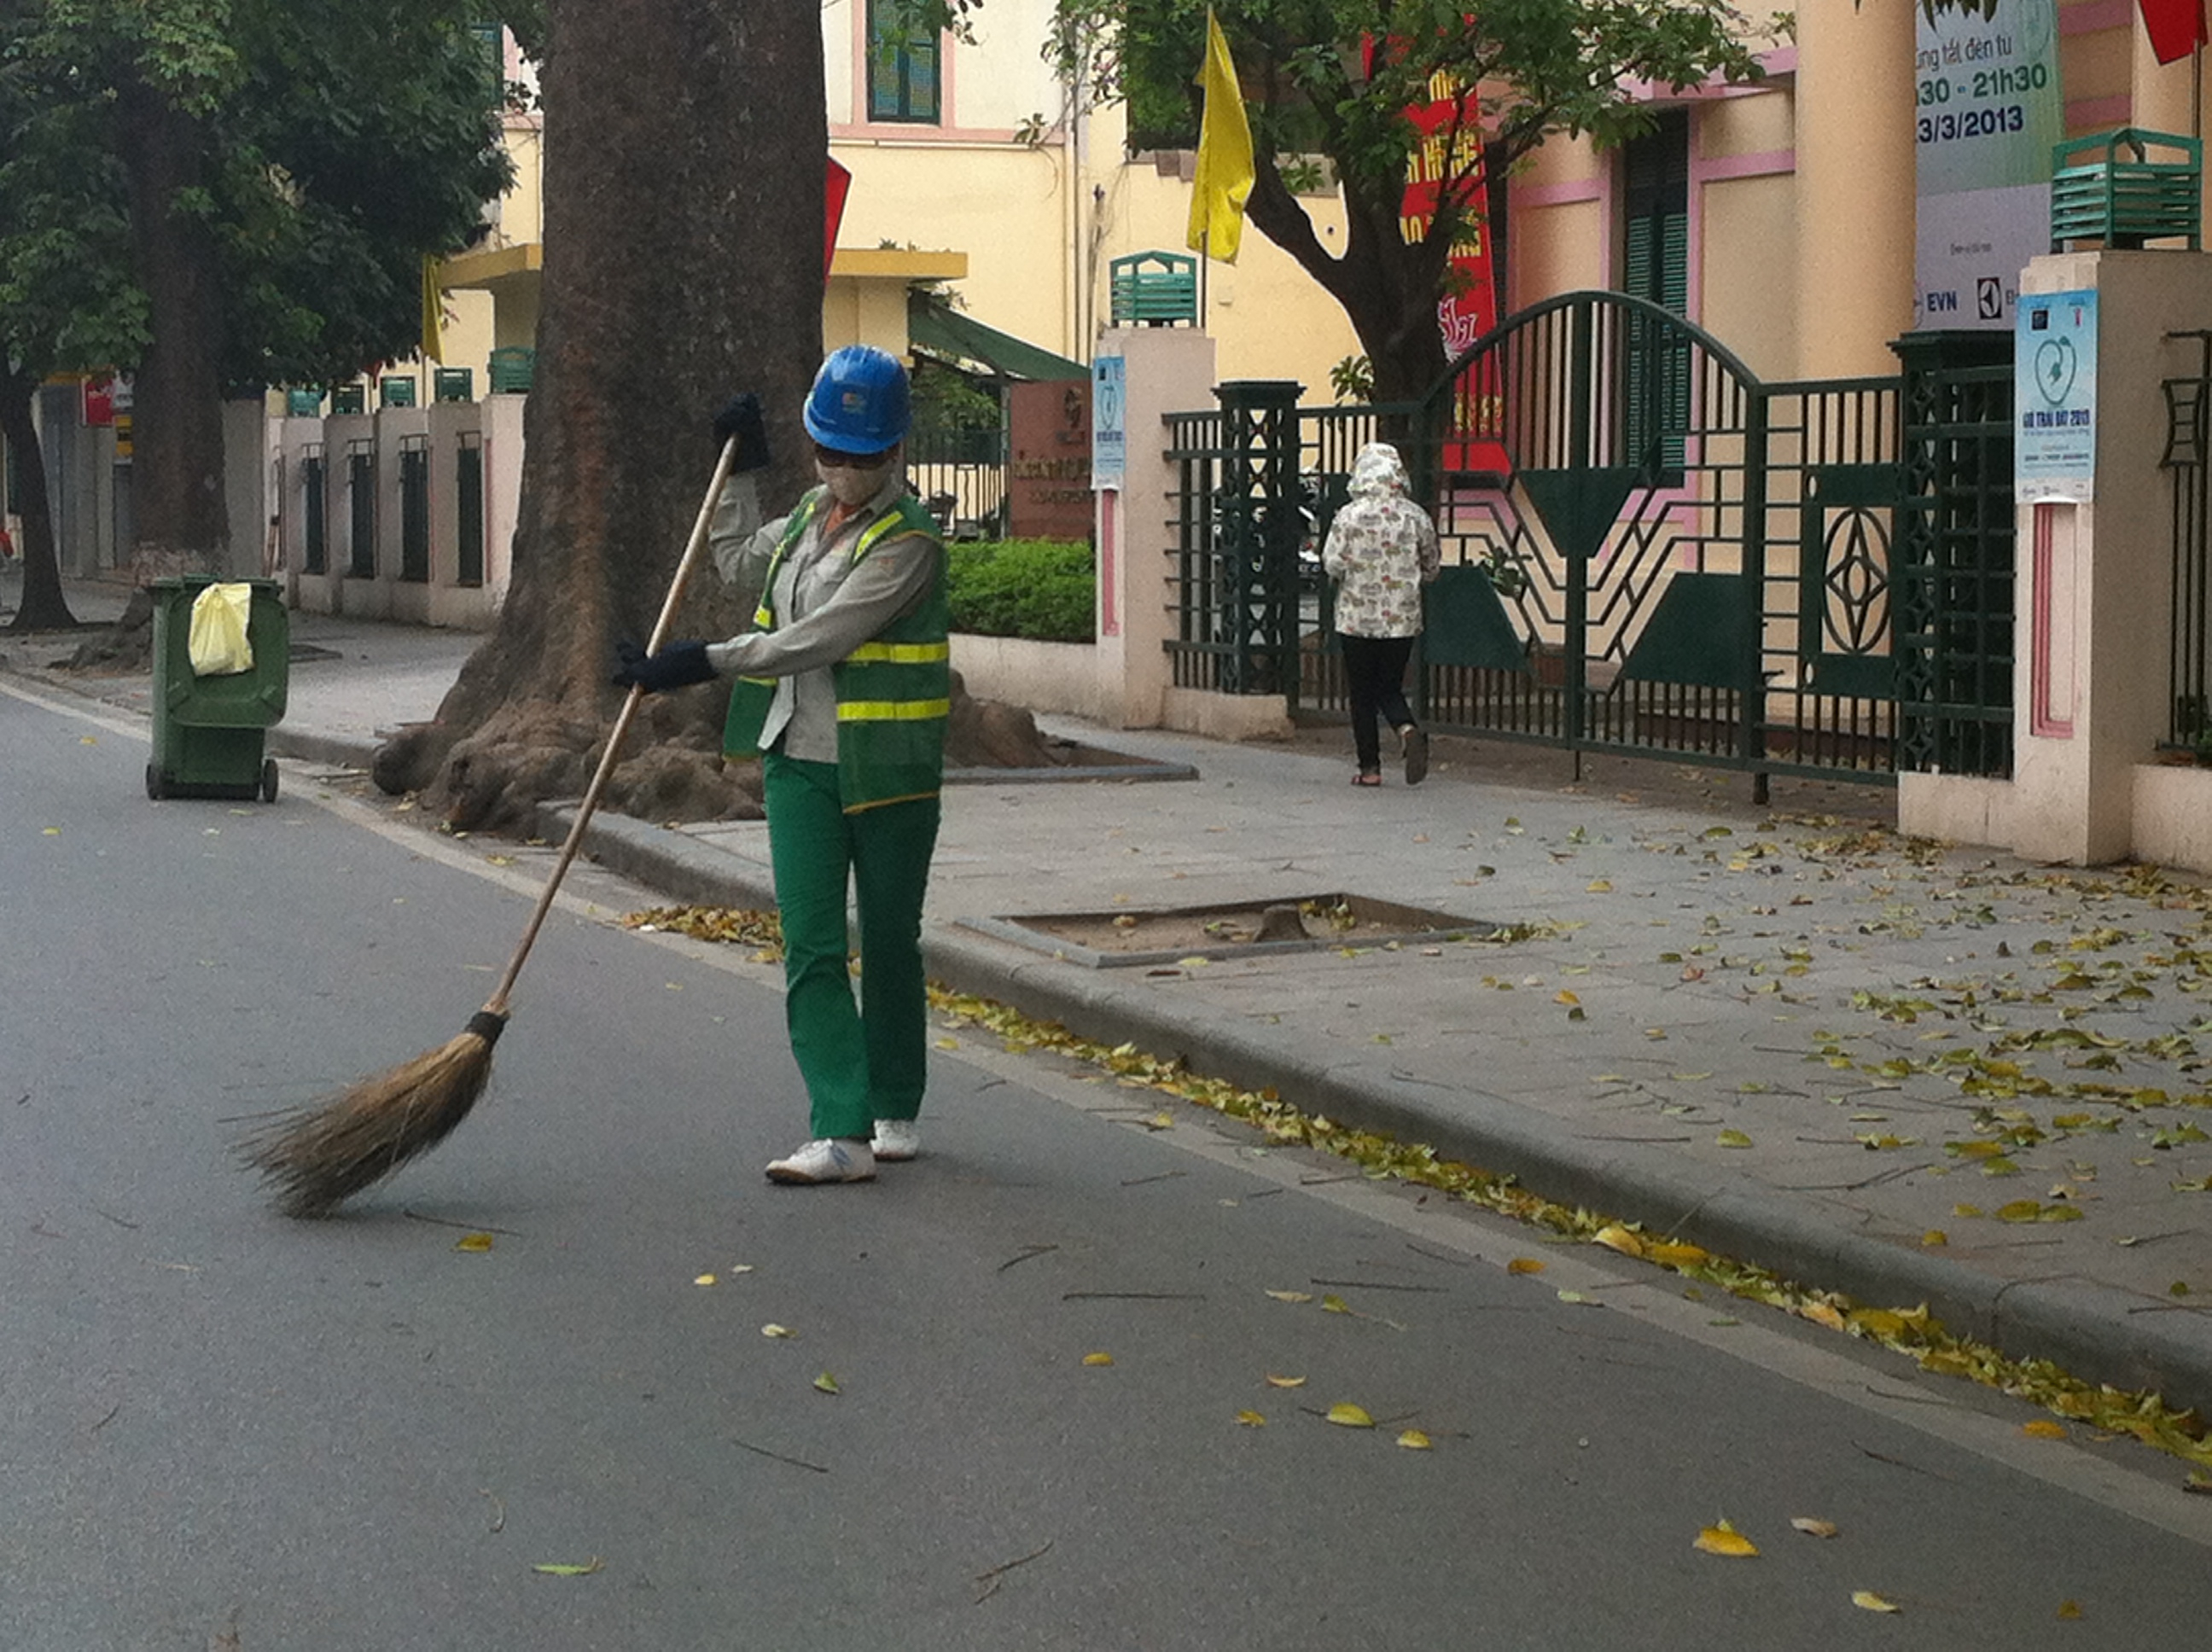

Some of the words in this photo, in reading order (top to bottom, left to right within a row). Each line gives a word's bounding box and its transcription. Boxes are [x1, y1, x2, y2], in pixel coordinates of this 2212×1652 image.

[1972, 62, 2046, 98] 21h30
[1915, 105, 2023, 144] 3/3/2013
[1927, 291, 1957, 312] EVN
